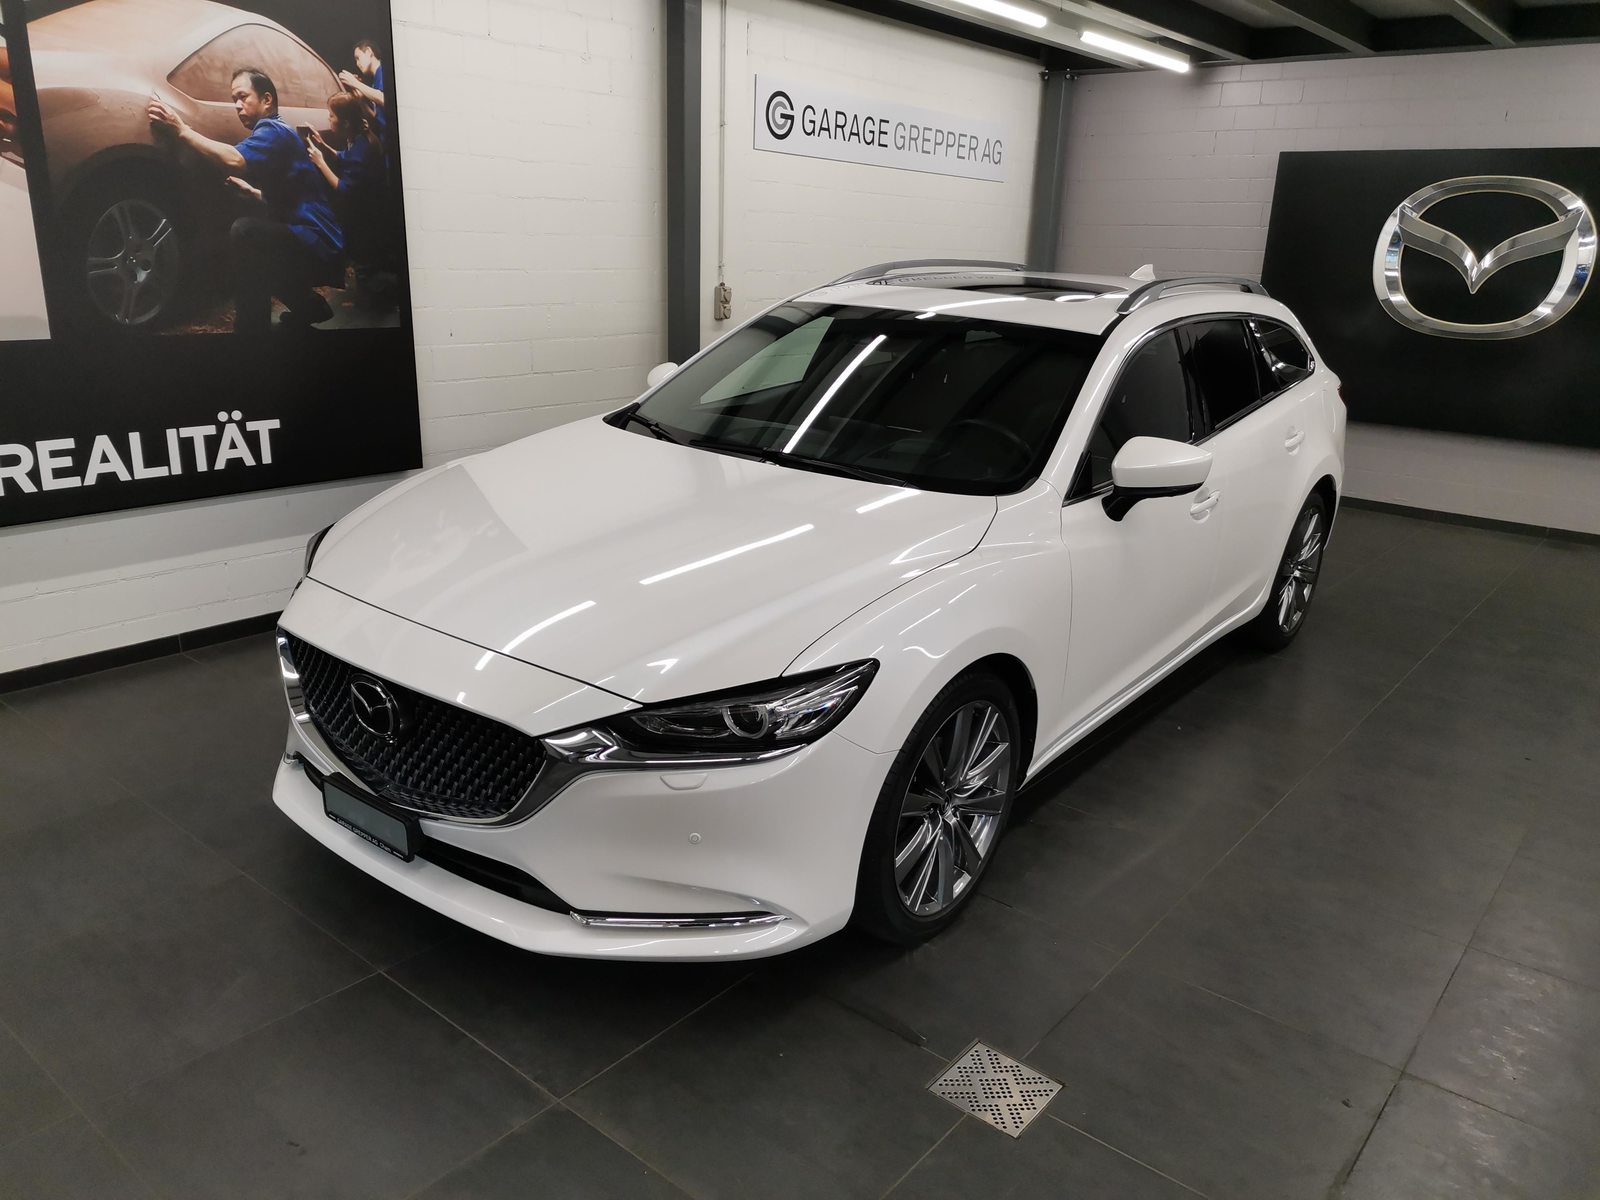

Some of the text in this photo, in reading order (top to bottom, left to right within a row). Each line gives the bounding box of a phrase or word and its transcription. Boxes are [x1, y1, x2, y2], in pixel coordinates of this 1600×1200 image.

[801, 104, 1003, 165] GARAGE GREPPER AG
[0, 410, 280, 496] REALITÄT
